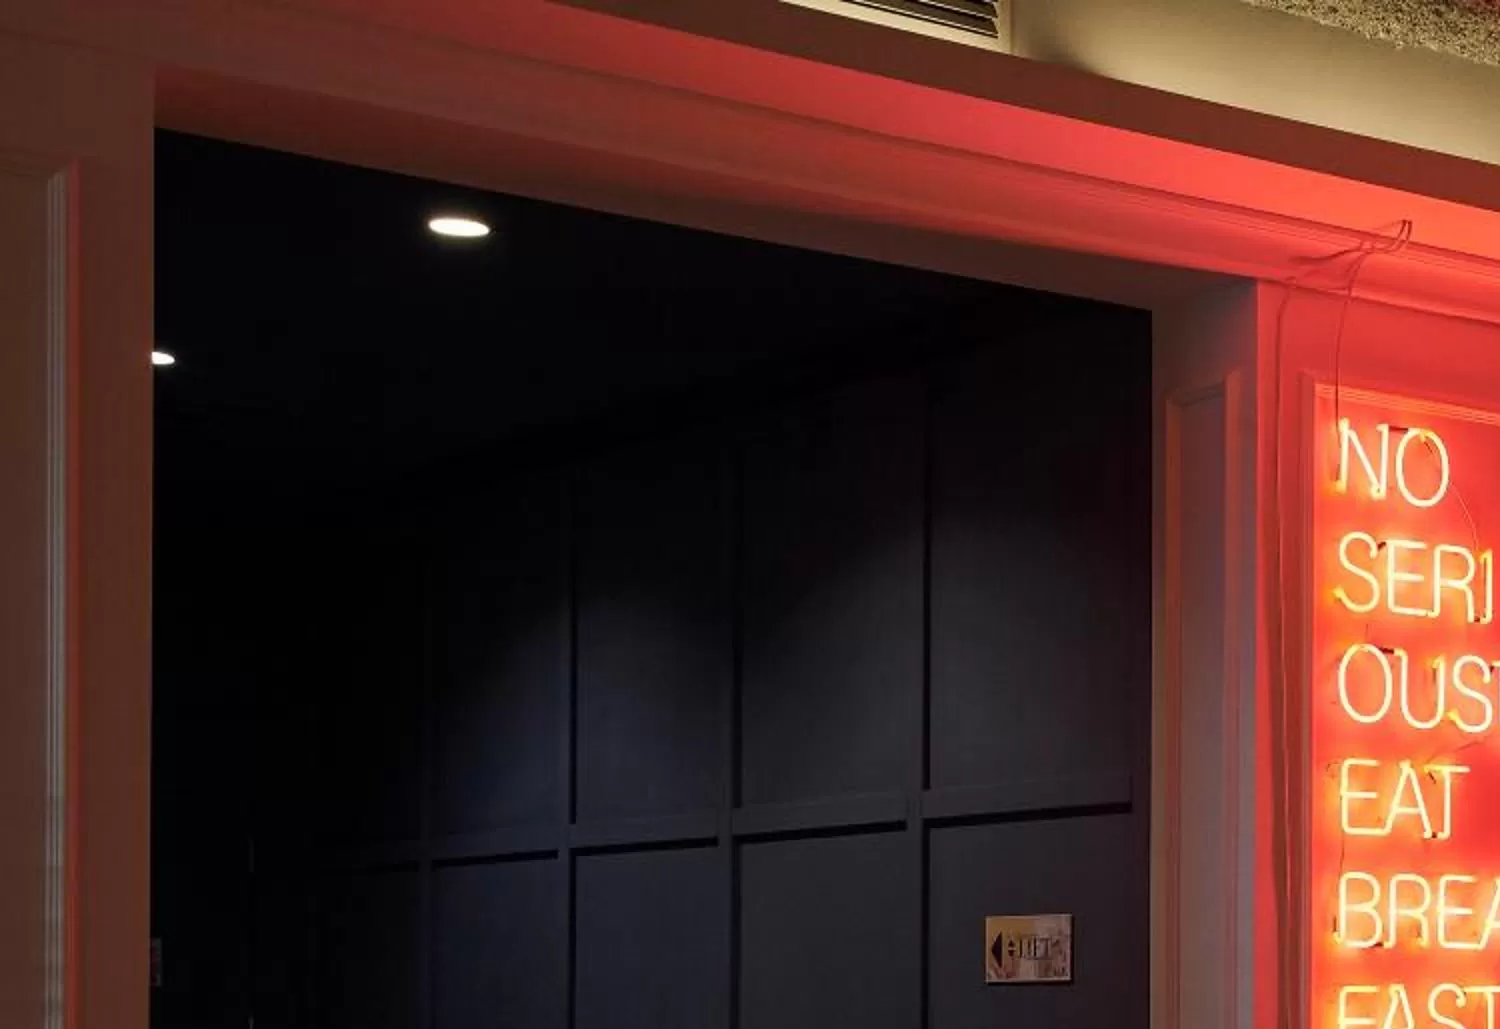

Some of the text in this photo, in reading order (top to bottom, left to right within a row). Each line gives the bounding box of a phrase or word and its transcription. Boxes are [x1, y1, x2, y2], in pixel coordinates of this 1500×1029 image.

[1334, 418, 1449, 507] NO
[1333, 531, 1494, 625] SERI
[1340, 758, 1471, 840] EAT
